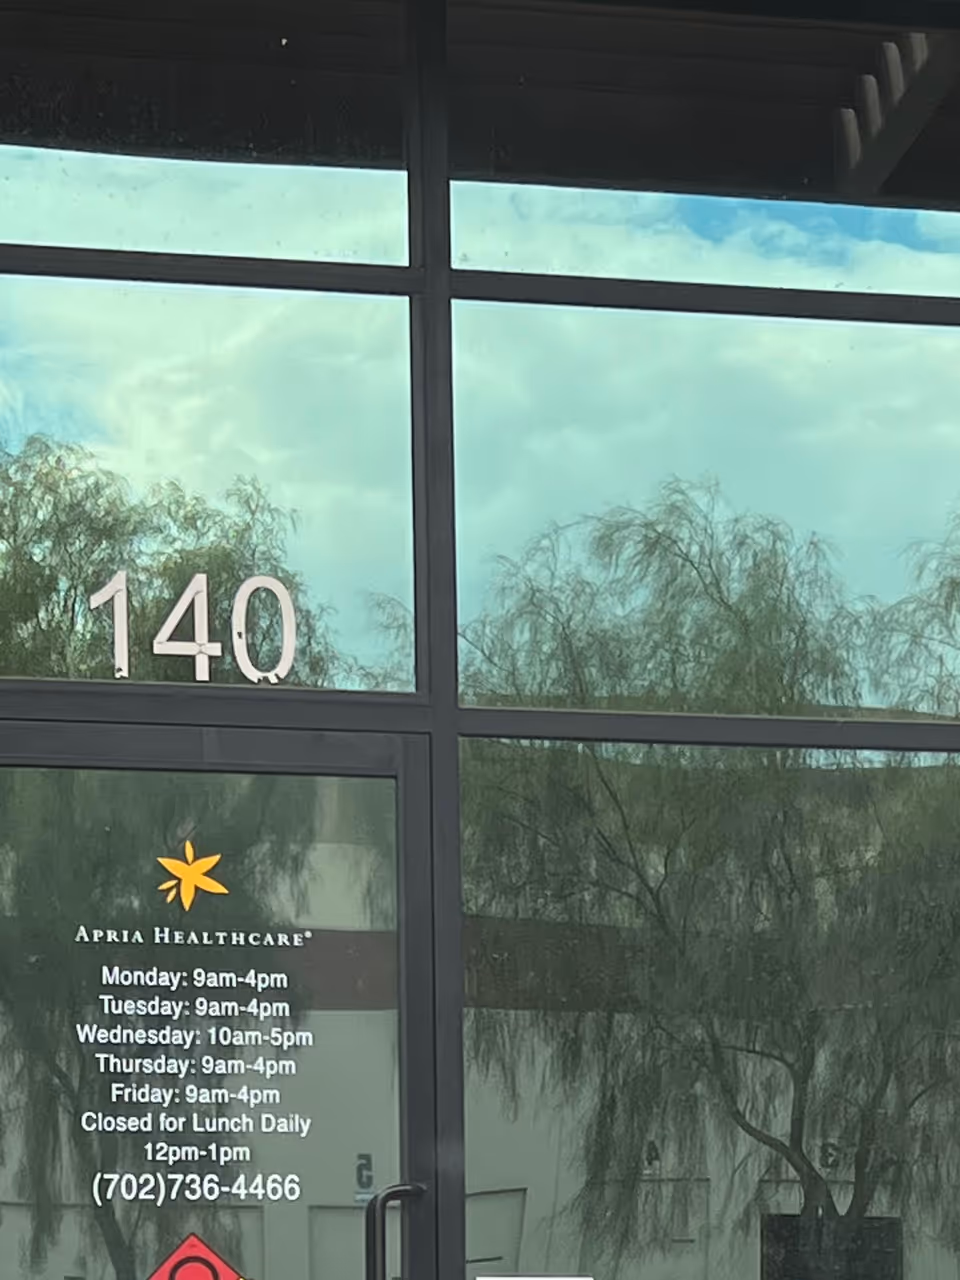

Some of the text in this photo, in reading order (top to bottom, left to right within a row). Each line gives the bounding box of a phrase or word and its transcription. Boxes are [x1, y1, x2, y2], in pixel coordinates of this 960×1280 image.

[90, 570, 297, 685] 140
[74, 924, 144, 944] APRIA
[101, 965, 289, 992] Monday: 9am-4pm
[99, 994, 290, 1021] Tuesday: 9am-4pm
[76, 1023, 313, 1050] Wednesday: 10am-5pm
[95, 1053, 296, 1079] Thursday: 9am-4pm
[111, 1083, 281, 1108] Friday: 9am-4pm
[81, 1111, 312, 1137] Closed for Lunch Daily
[144, 1142, 250, 1166] 12pm-1pm
[92, 1172, 301, 1207] (702)736-4466
